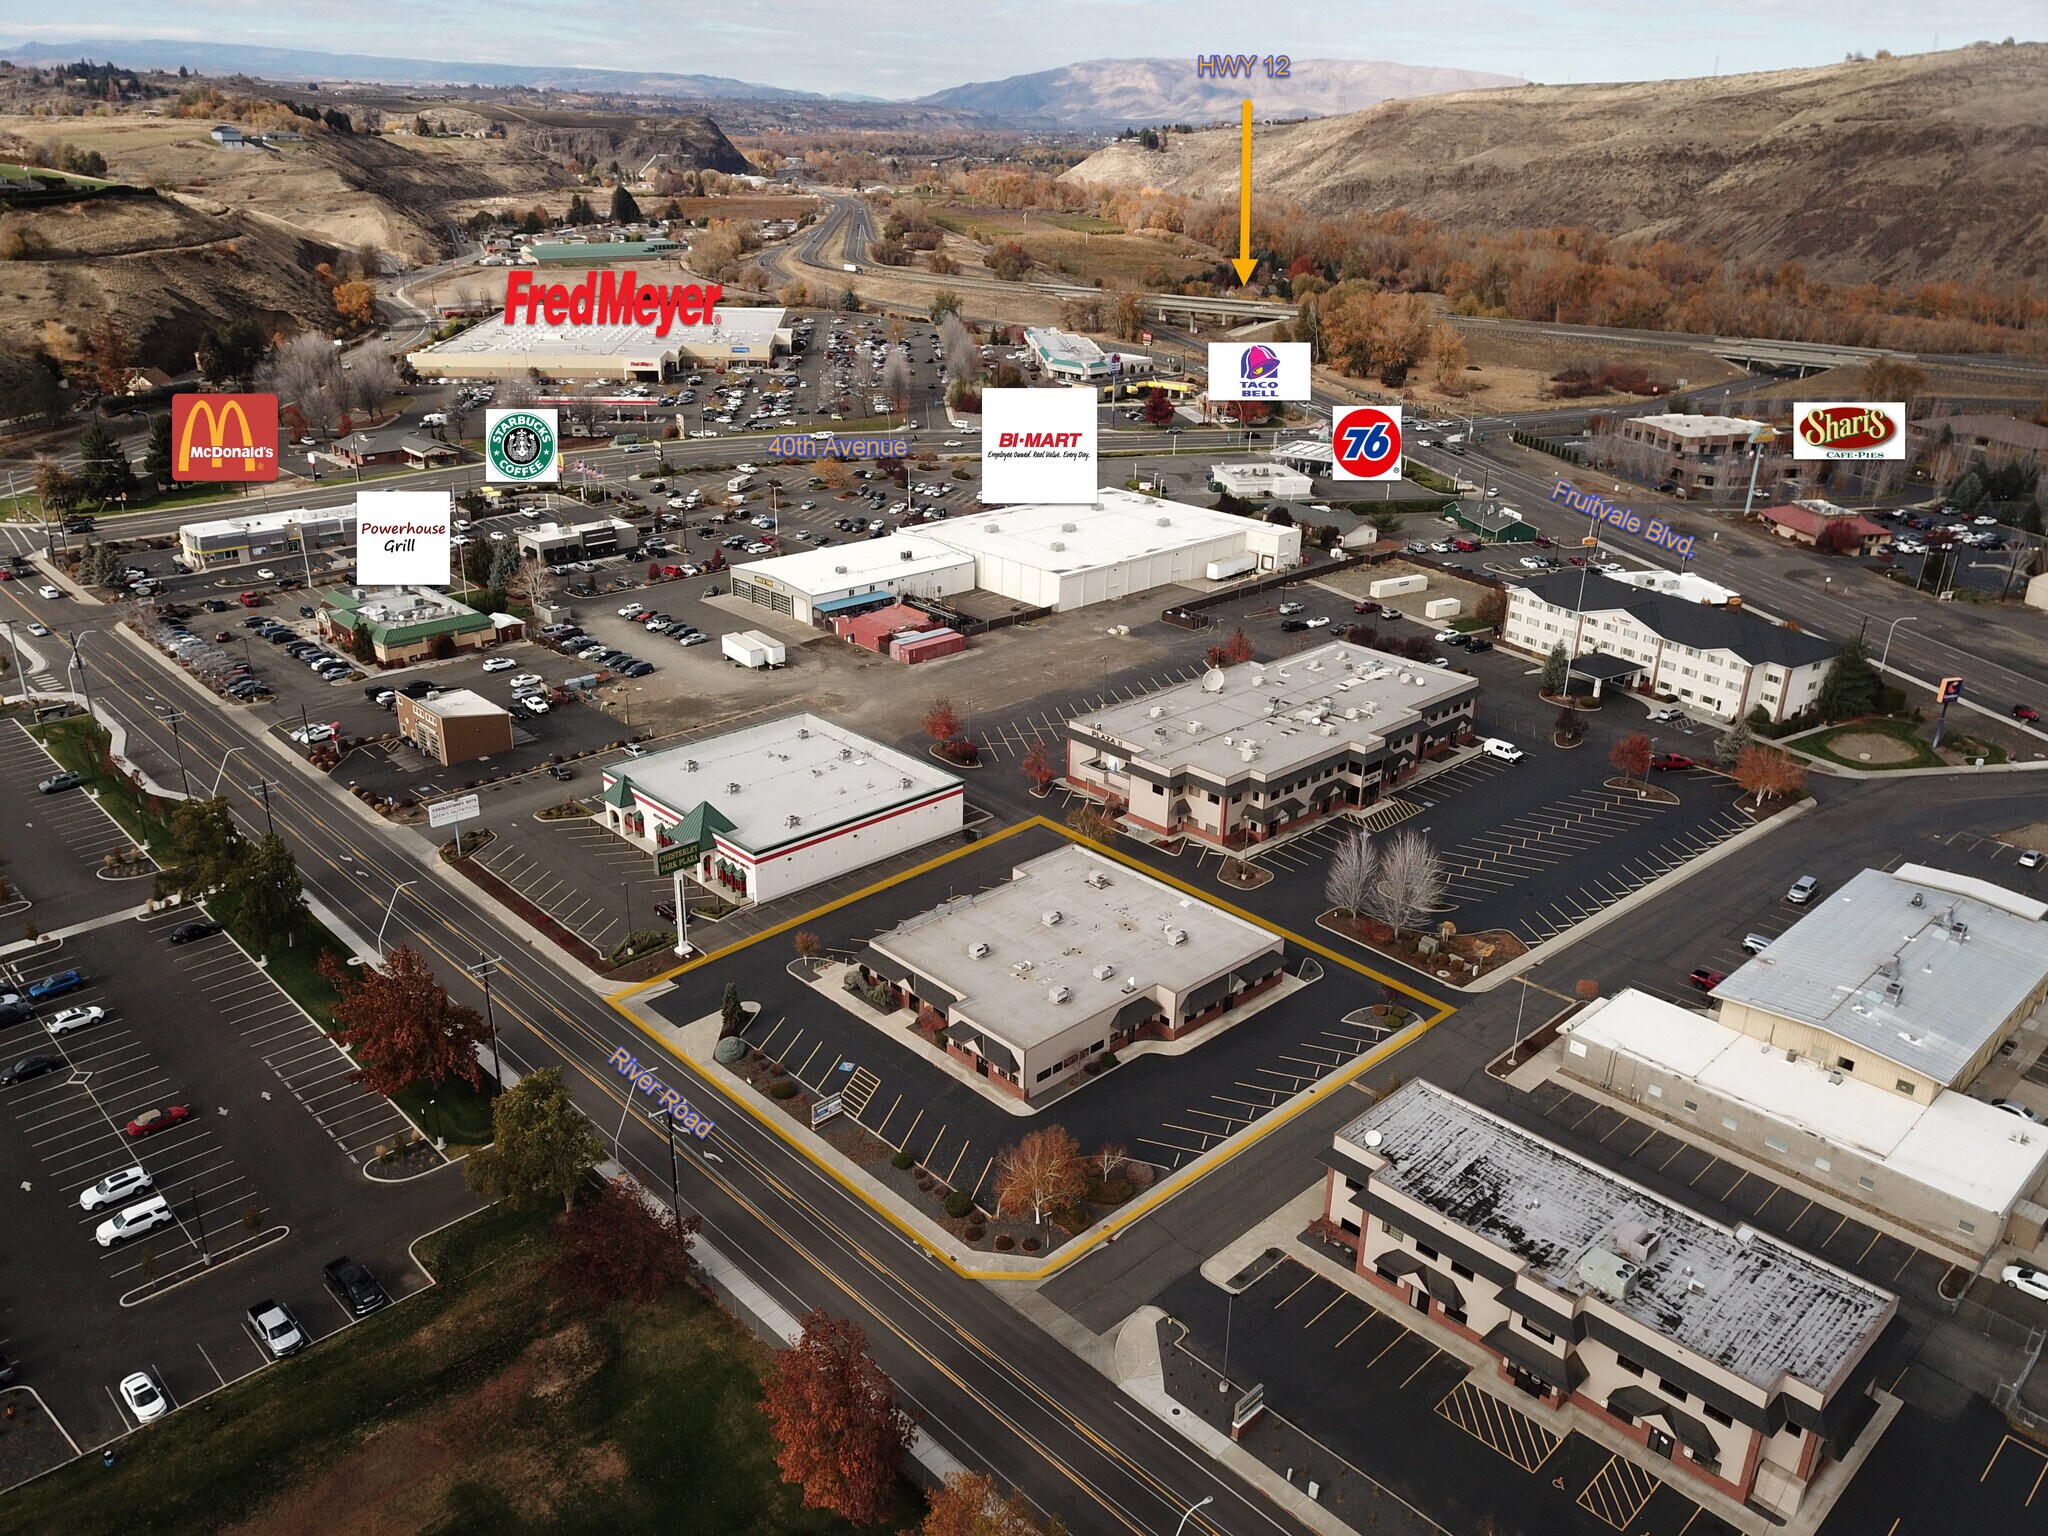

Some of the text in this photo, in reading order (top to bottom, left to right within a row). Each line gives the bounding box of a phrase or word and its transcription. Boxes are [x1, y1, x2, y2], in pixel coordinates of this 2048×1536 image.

[1091, 731, 1115, 745] PLAZA
[660, 845, 699, 863] CHESTERLEY
[660, 855, 699, 872] PARK PLAZA
